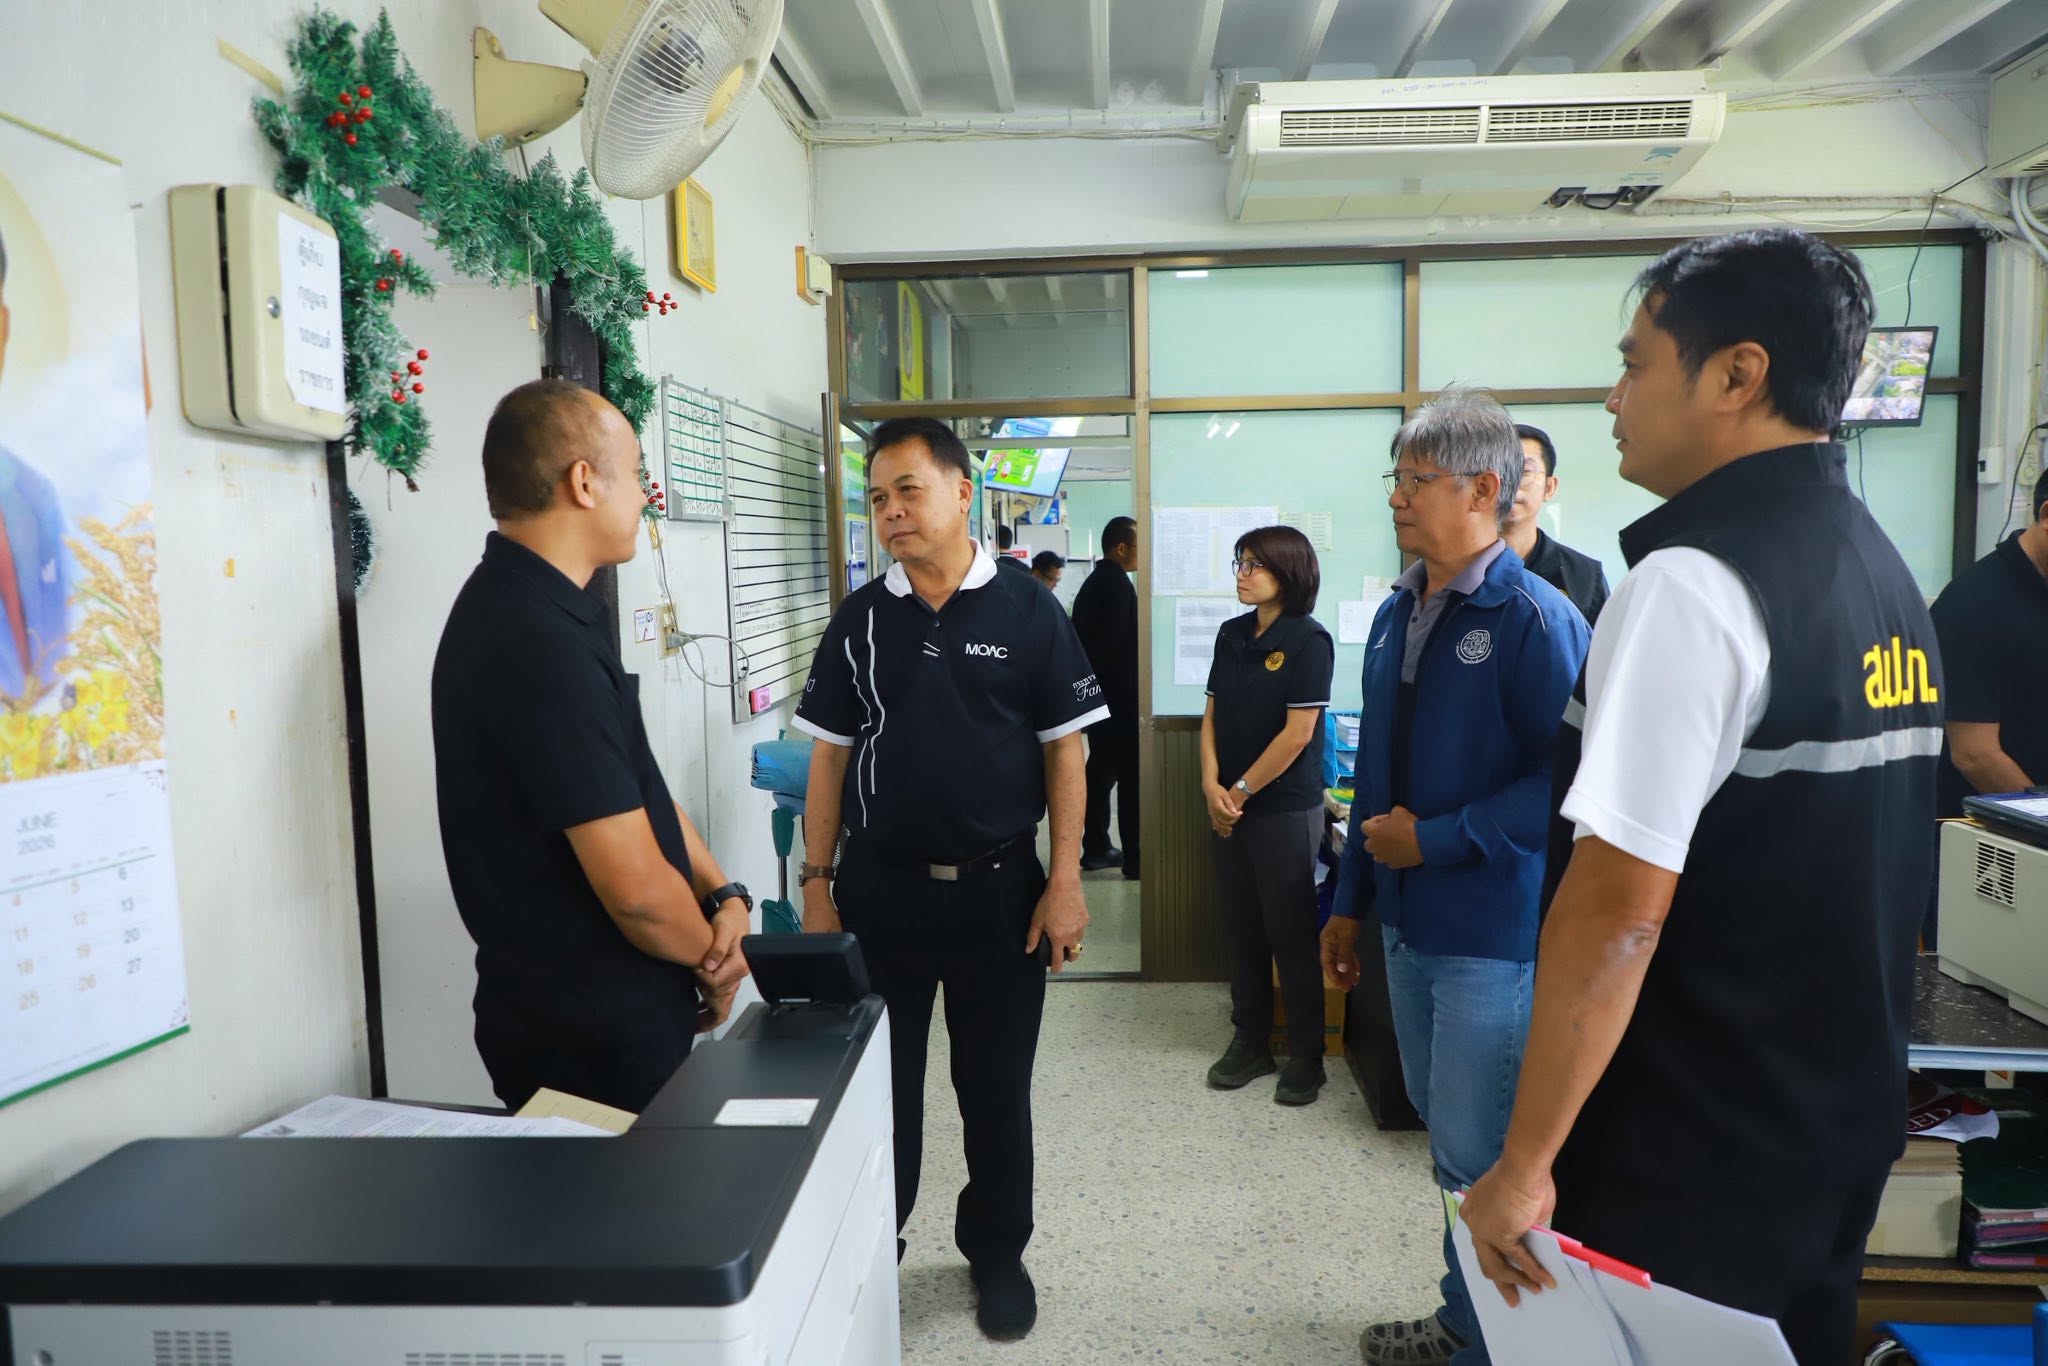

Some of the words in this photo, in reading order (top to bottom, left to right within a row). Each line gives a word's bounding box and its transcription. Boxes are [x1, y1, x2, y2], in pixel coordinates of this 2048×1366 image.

[965, 642, 1009, 659] MOAC
[16, 811, 57, 834] JUNE
[118, 866, 128, 880] 6
[121, 897, 135, 912] 13
[123, 927, 141, 944] 20
